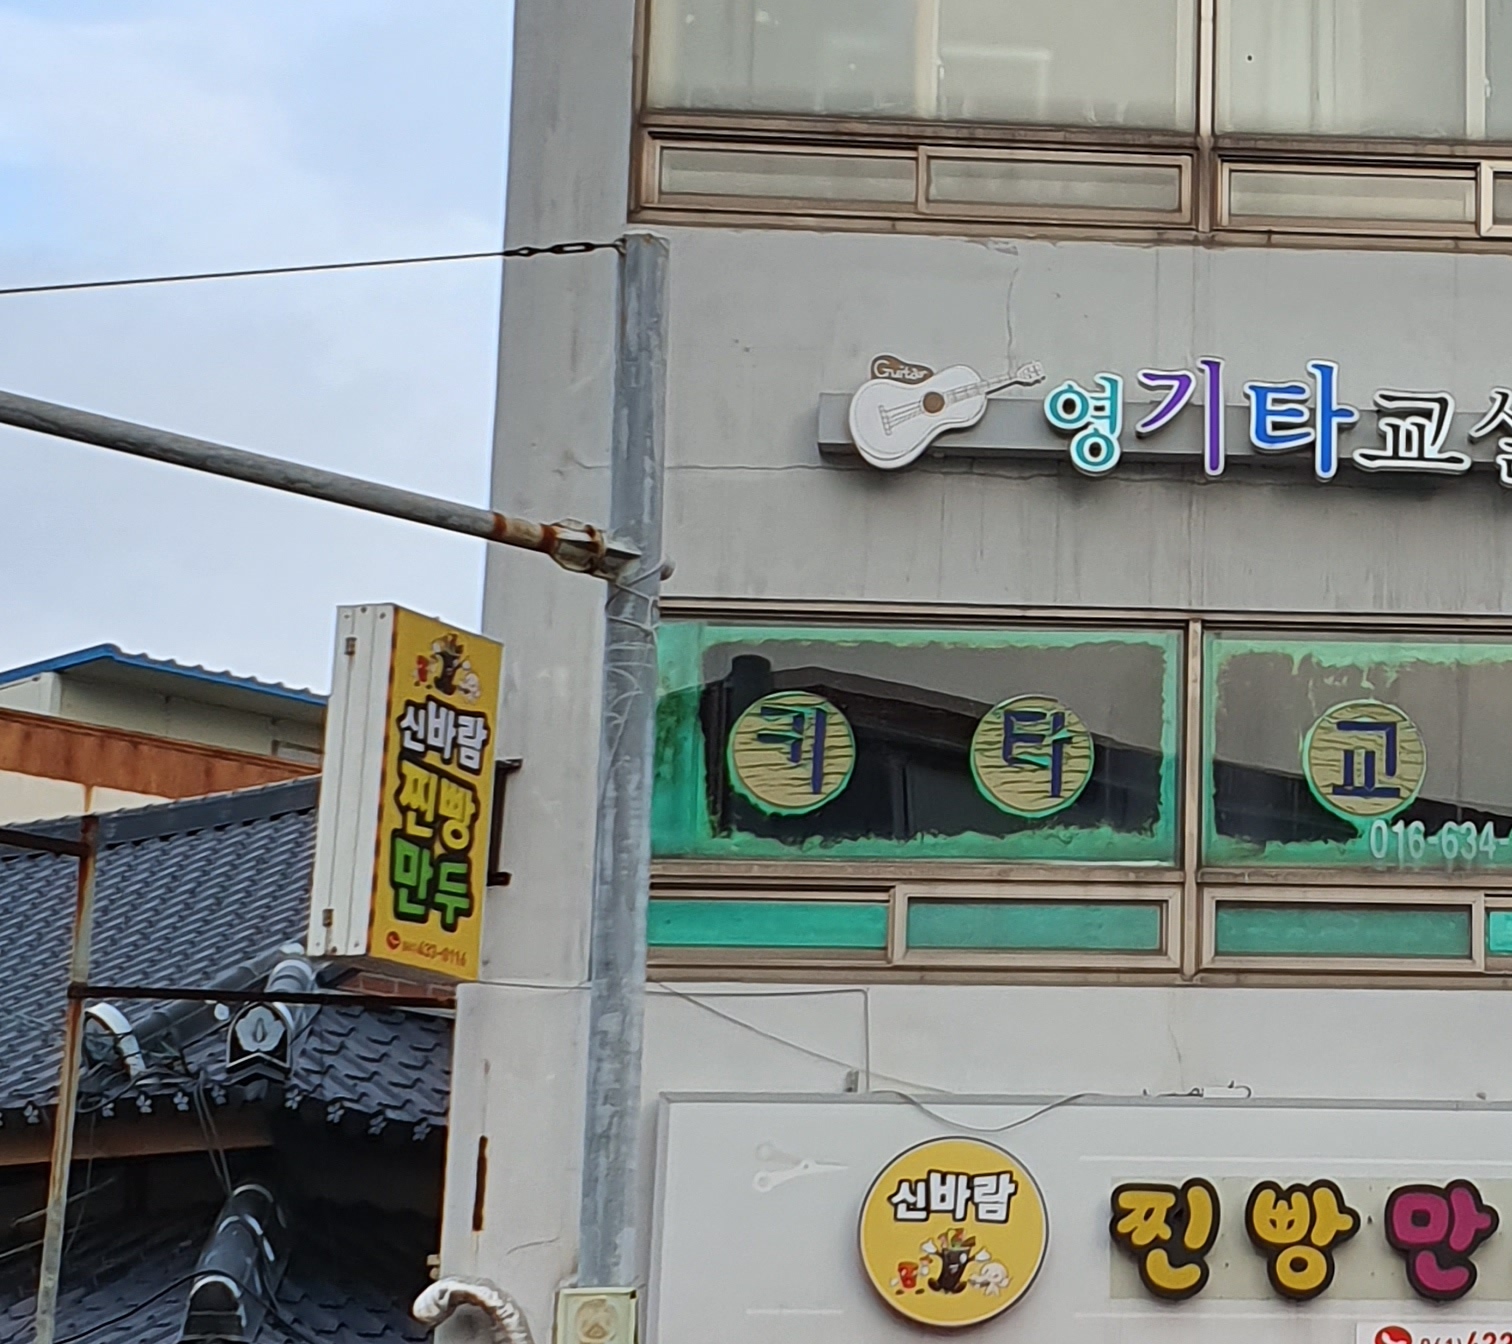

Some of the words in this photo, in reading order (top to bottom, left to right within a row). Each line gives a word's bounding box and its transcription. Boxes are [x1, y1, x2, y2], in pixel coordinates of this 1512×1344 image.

[873, 359, 929, 380] Guitar
[397, 694, 489, 774] 신바람
[396, 760, 478, 854] 찐빵
[391, 828, 475, 933] 만두
[887, 1169, 1018, 1223] 신바람
[1110, 1177, 1361, 1301] 찐빵
